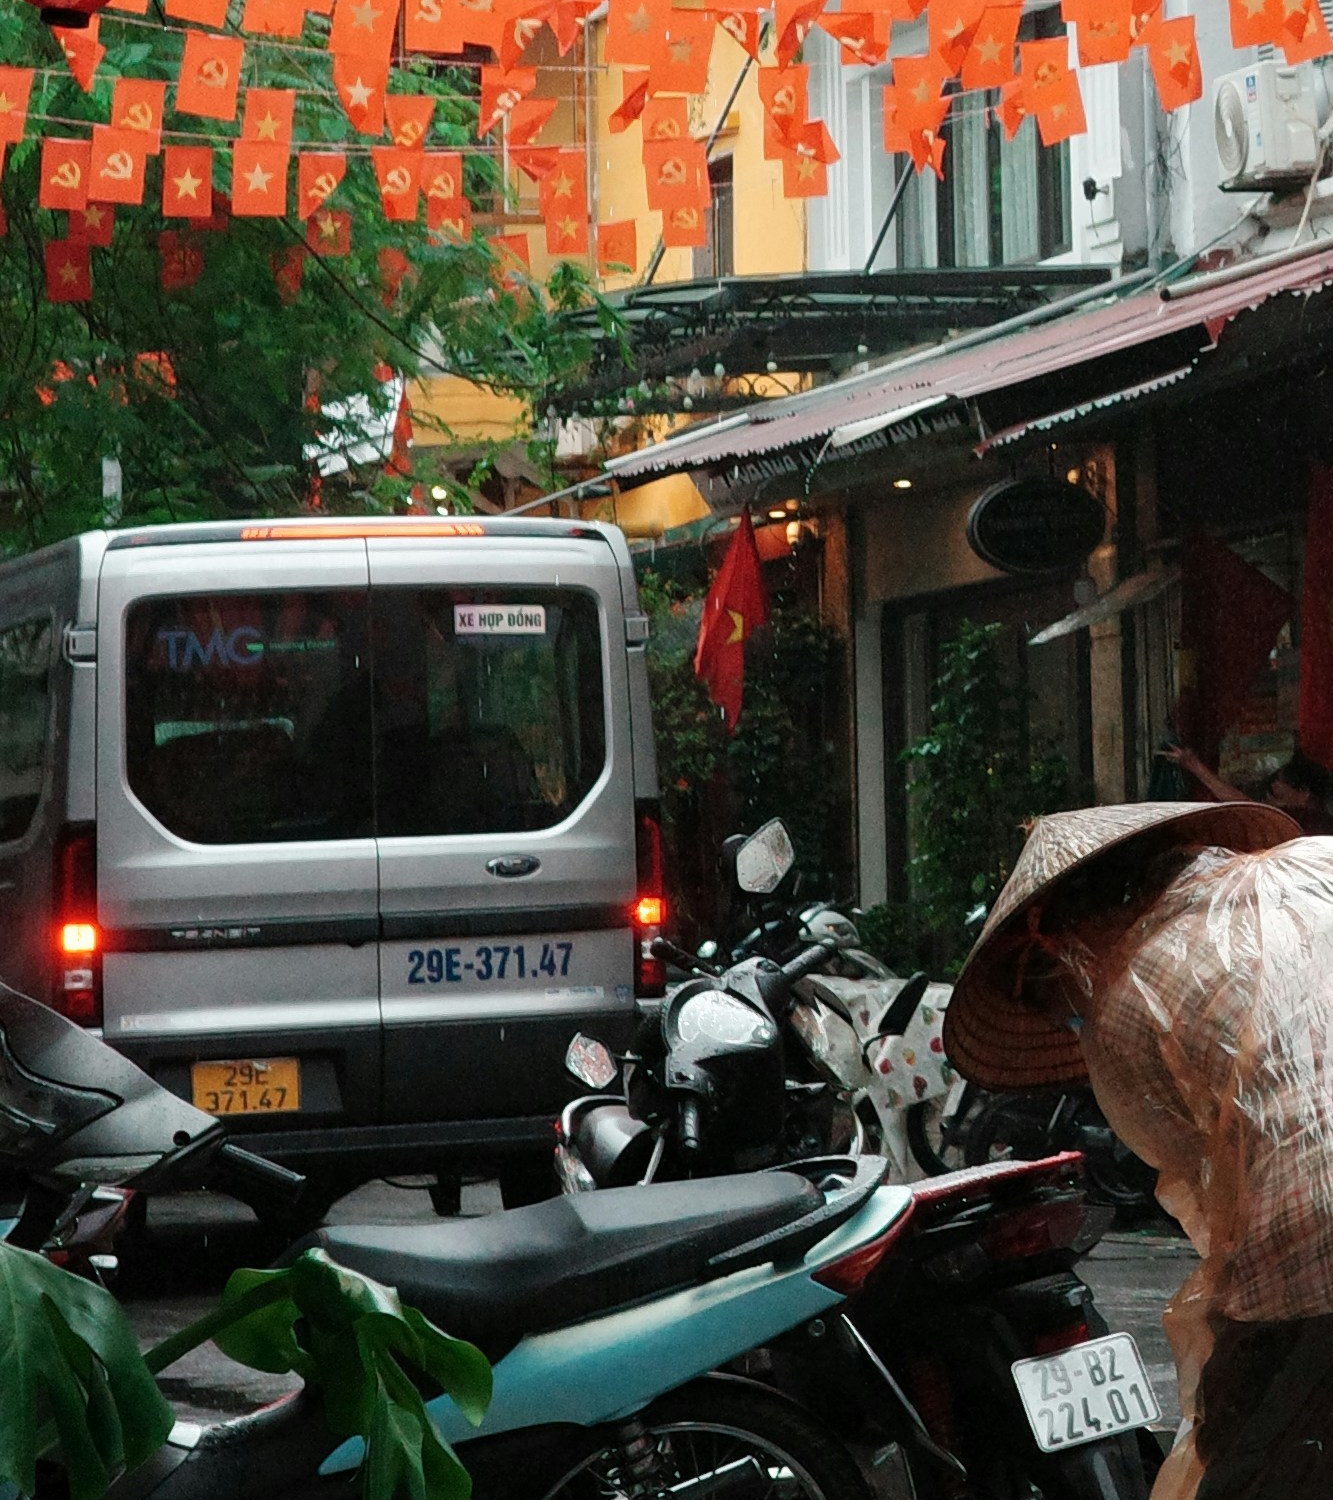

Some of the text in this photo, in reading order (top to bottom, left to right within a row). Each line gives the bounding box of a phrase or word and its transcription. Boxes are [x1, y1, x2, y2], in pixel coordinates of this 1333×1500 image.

[459, 613, 474, 627] XE
[408, 943, 573, 984] 29E-371.47
[206, 1087, 287, 1113] 371.47
[1032, 1345, 1125, 1401] 29-B2
[1038, 1383, 1149, 1446] 224.01
